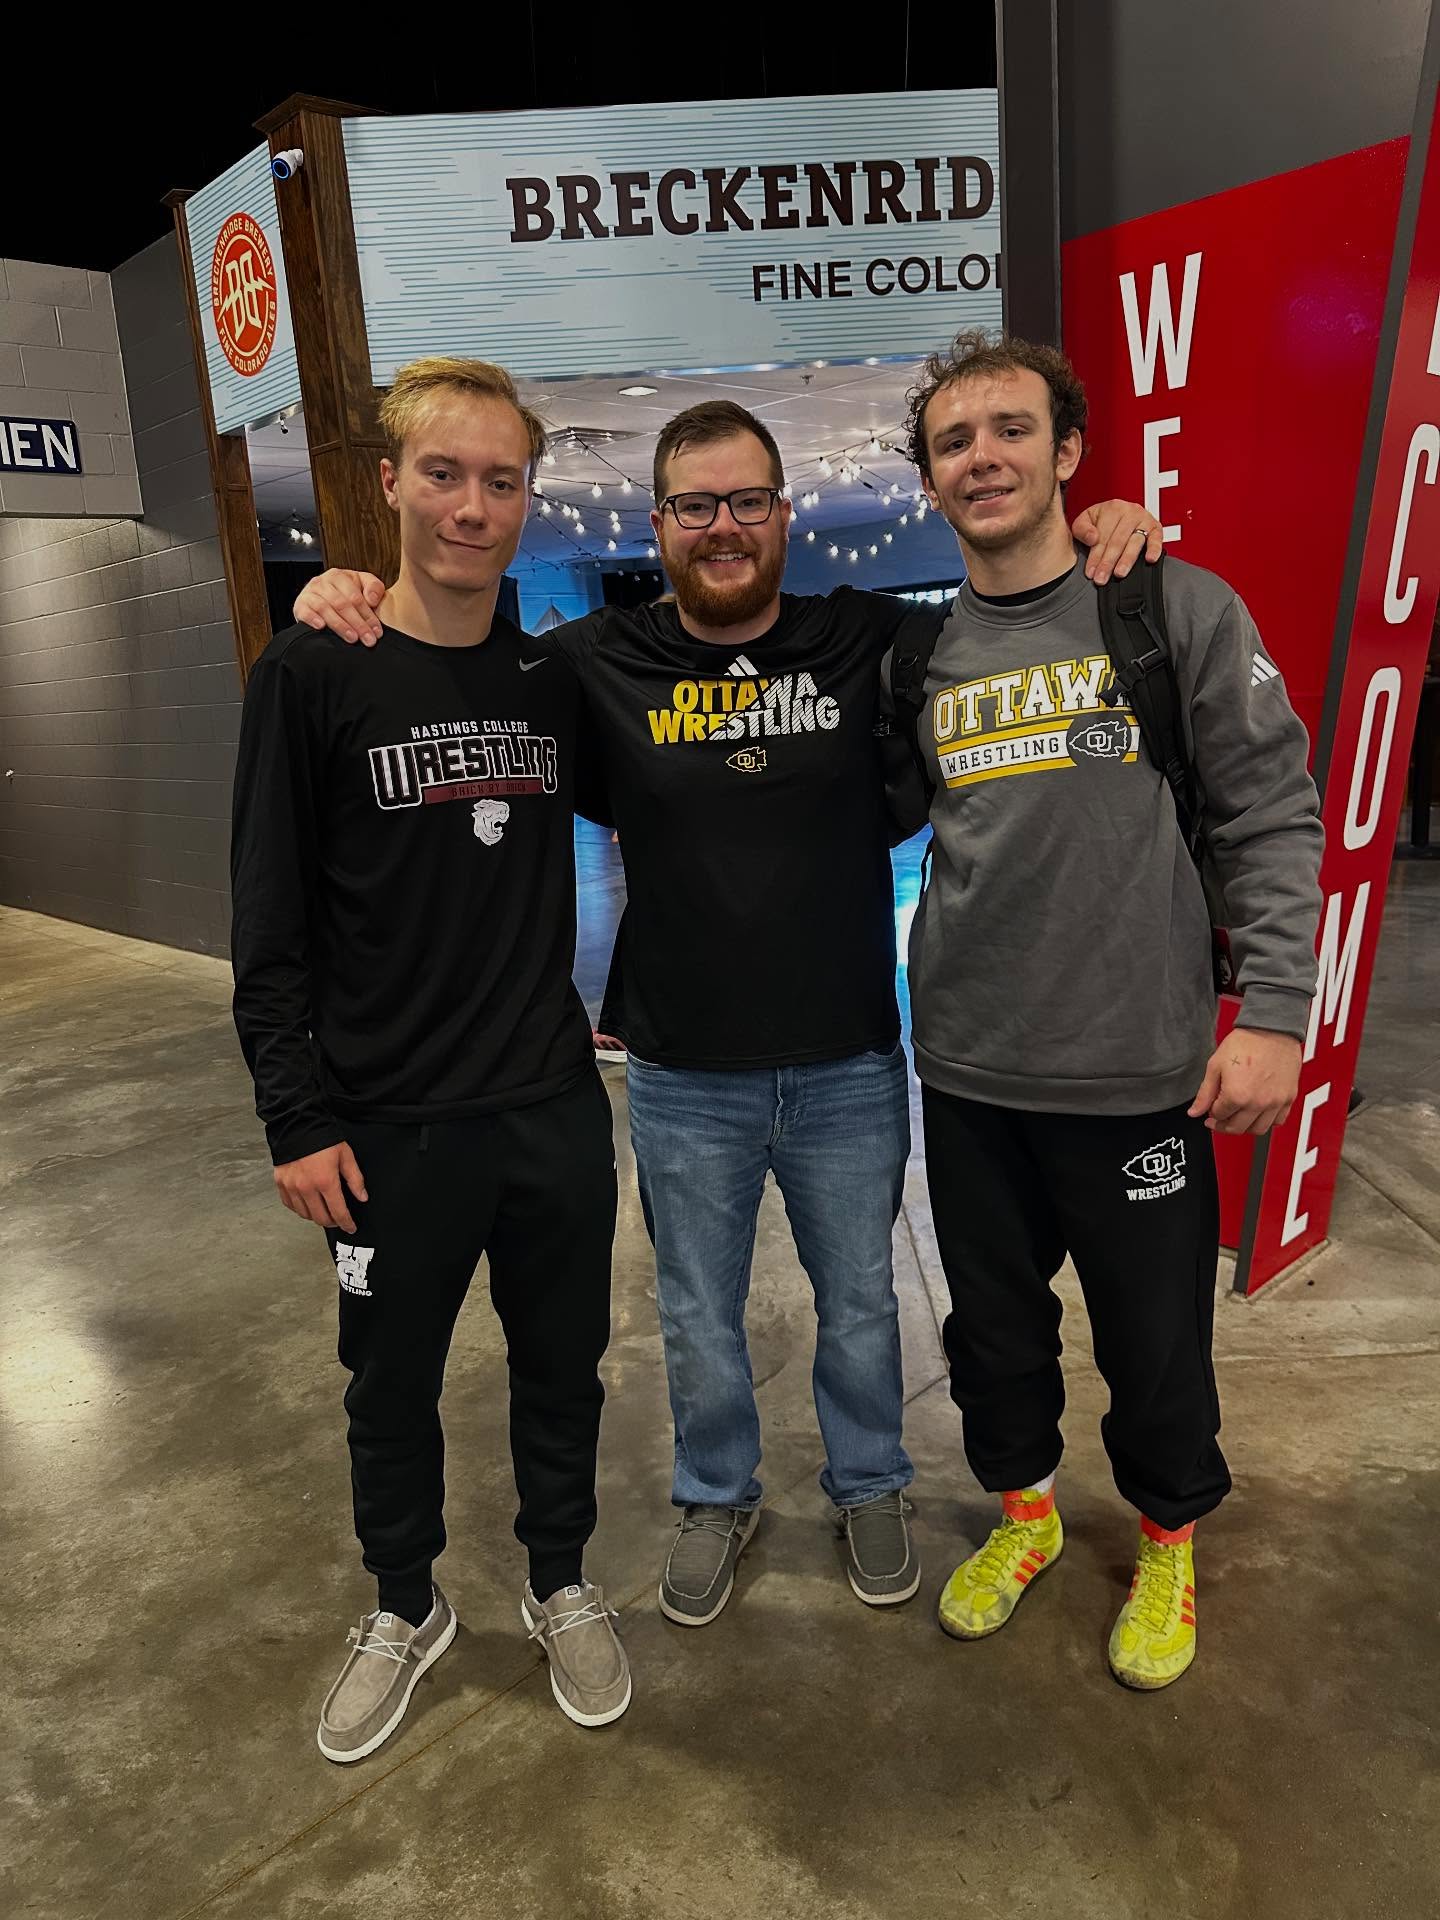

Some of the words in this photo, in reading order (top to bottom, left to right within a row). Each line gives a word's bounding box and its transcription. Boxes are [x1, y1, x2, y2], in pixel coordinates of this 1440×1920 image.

[506, 156, 995, 243] BRECKENRID
[213, 217, 243, 306] BRECKENRIDGE
[244, 219, 273, 277] BREWERY
[753, 259, 853, 301] FINE
[219, 327, 233, 360] FINE
[234, 345, 269, 372] COLORADO
[266, 300, 275, 340] ALES
[673, 672, 818, 713] OTTAWA
[934, 654, 1132, 742] OTTAW
[411, 720, 479, 740] HASTINGS
[483, 720, 529, 734] COLLEGE
[647, 696, 840, 745] WRESTLING
[737, 753, 756, 769] OU
[946, 737, 1060, 773] WRESTLING
[1086, 730, 1113, 753] OU
[368, 735, 557, 810] WRESTLING
[451, 785, 485, 798] BRICK
[488, 783, 501, 793] BY
[1142, 1153, 1171, 1177] OU
[1126, 1175, 1186, 1201] WRESTLING
